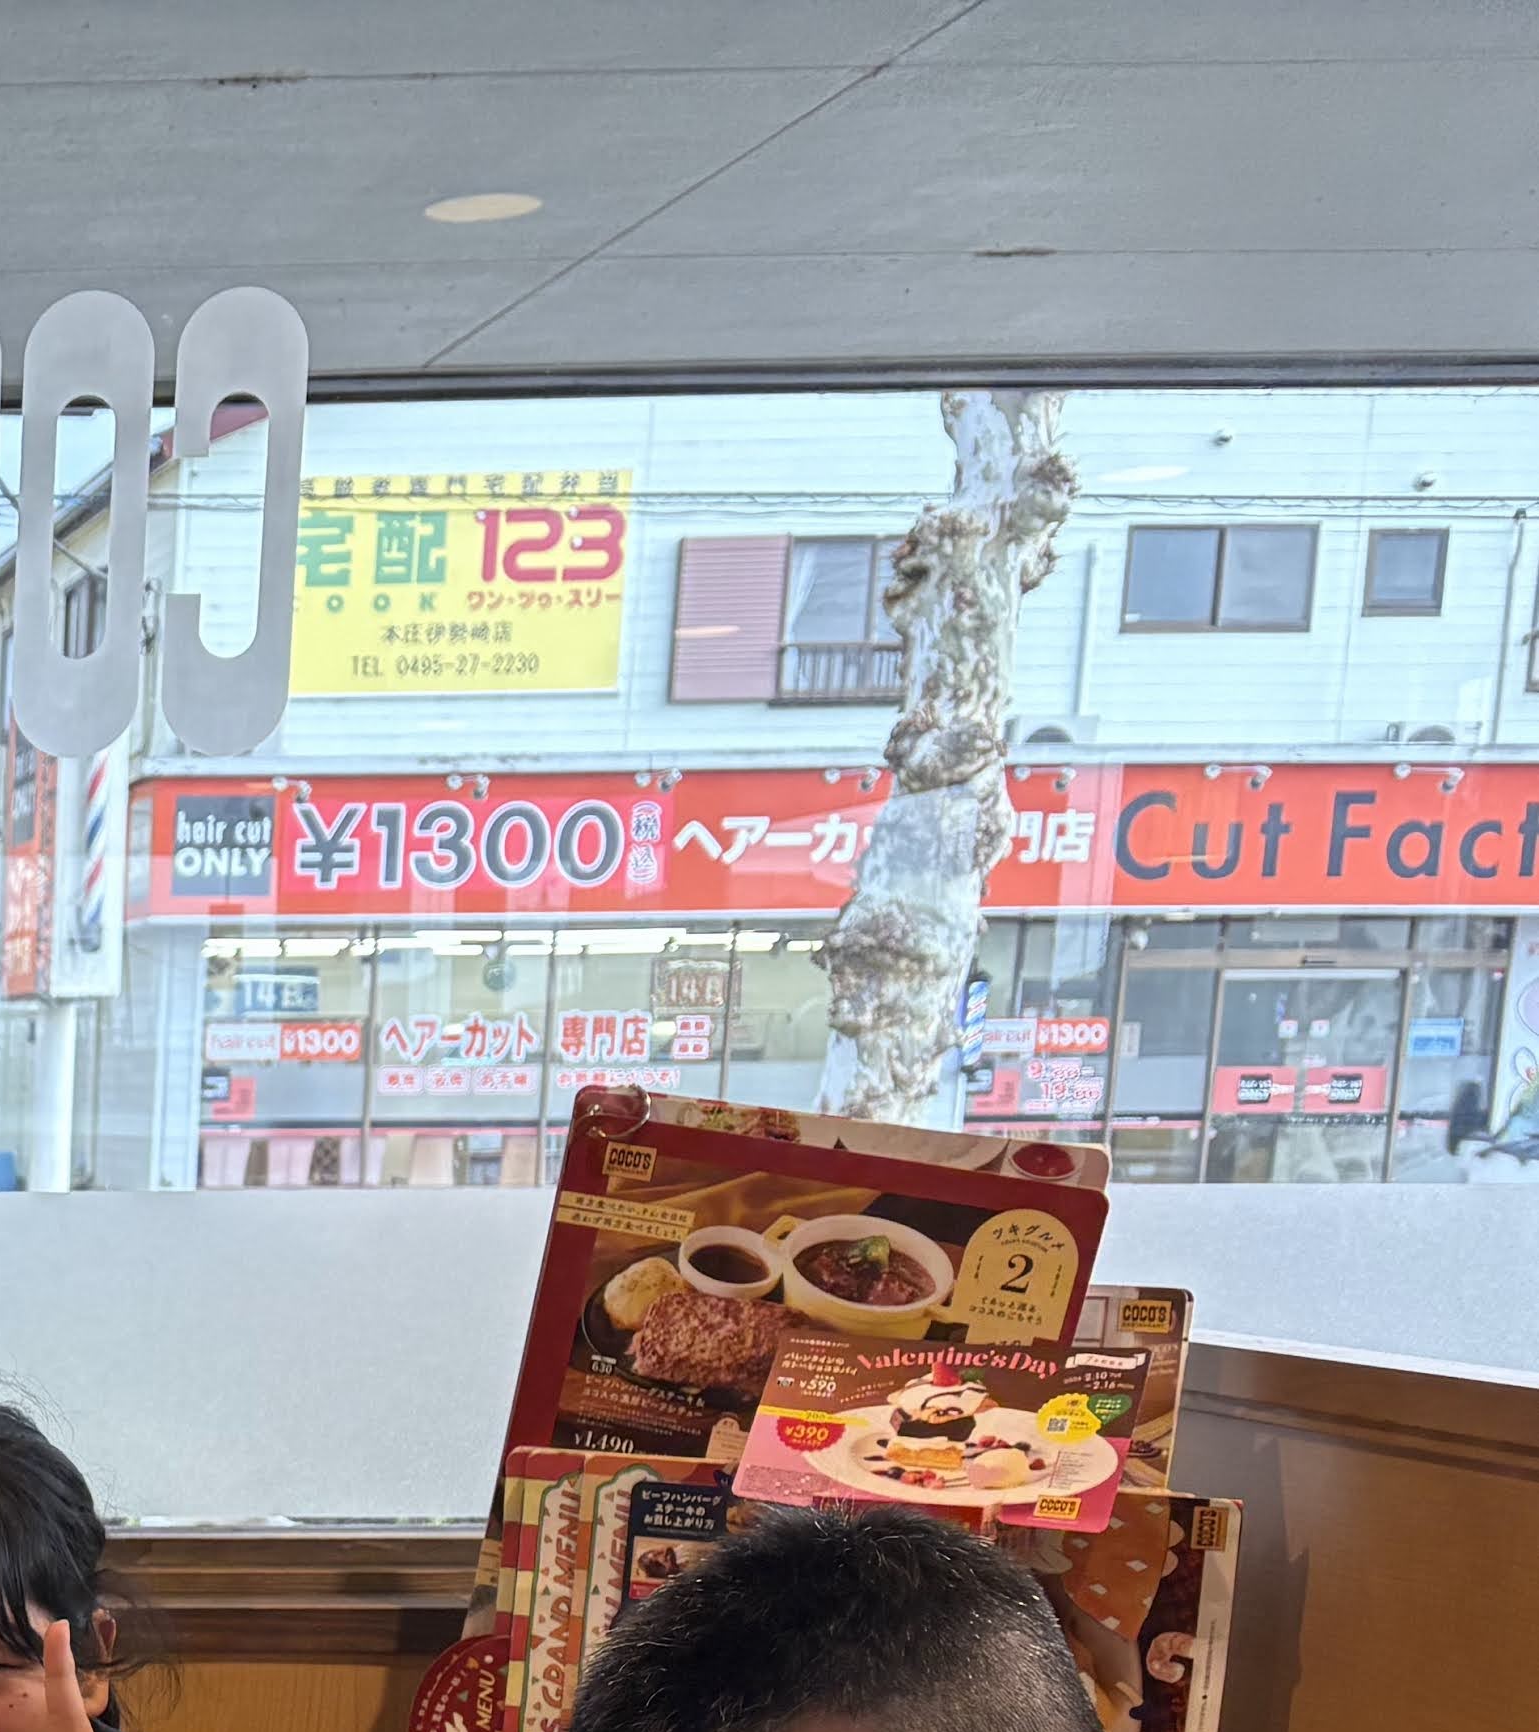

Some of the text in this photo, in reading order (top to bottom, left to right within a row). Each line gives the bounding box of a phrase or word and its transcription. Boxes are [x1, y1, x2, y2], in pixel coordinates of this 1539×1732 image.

[474, 503, 626, 583] 123
[351, 655, 383, 677] TEL
[177, 811, 272, 846] hair cut
[292, 799, 626, 890] ¥1300
[1113, 790, 1293, 881] Cut
[175, 846, 272, 878] ONLY
[384, 1016, 536, 1058] ヘアーカット
[559, 1015, 649, 1058] 専門店
[608, 1148, 651, 1170] COCO'S
[999, 1253, 1034, 1294] 2
[1122, 1303, 1168, 1323] COCO'S
[857, 1346, 1059, 1380] Valentine's Day
[784, 1424, 829, 1442] ¥390
[641, 1489, 723, 1507] ビーフハンバーグ
[654, 1503, 706, 1517] ステーキの
[554, 1489, 581, 1589] MENU
[474, 1668, 496, 1732] MENU
